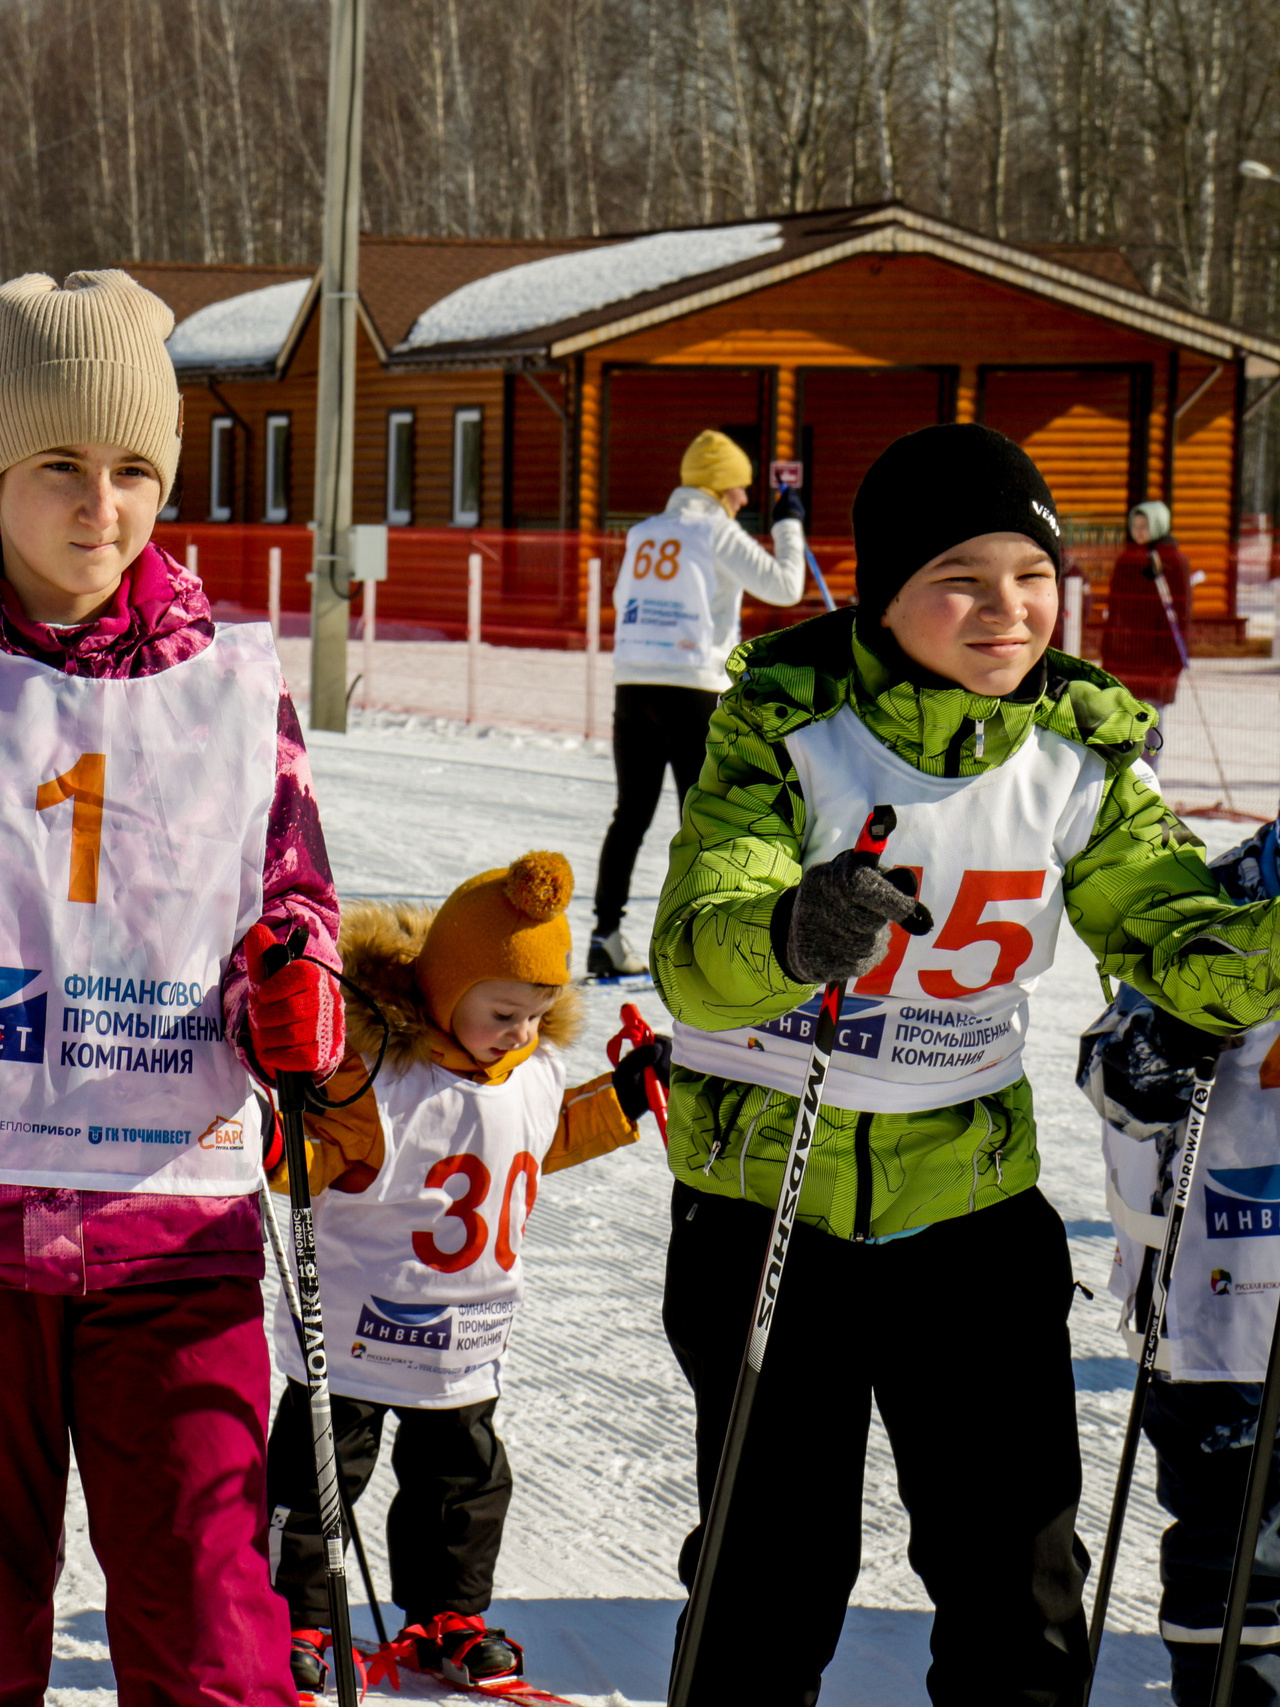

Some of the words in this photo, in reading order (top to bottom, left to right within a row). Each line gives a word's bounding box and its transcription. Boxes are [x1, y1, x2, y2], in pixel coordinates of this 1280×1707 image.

[633, 539, 681, 581] 68
[36, 753, 106, 904] 1
[63, 1007, 225, 1042] ПРОМЫШЛЕНН
[765, 1016, 873, 1050] НВСТ
[60, 1041, 193, 1074] КОМПАНИЯ
[891, 1047, 985, 1067] КОМПАНИЯ
[105, 1127, 120, 1142] ГК
[122, 1128, 192, 1145] ТОЧИНВЕСТ
[1177, 1116, 1201, 1201] NORDWAY
[757, 1055, 827, 1330] MADSHUS
[412, 1151, 539, 1273] 30
[1214, 1208, 1272, 1231] ИНВ
[294, 1211, 305, 1257] NORDIC
[363, 1321, 447, 1346] ИНВЕСТ
[456, 1330, 502, 1351] КОМПАНИЯ
[1147, 1317, 1160, 1349] ACTIVE
[1143, 1349, 1156, 1370] XC
